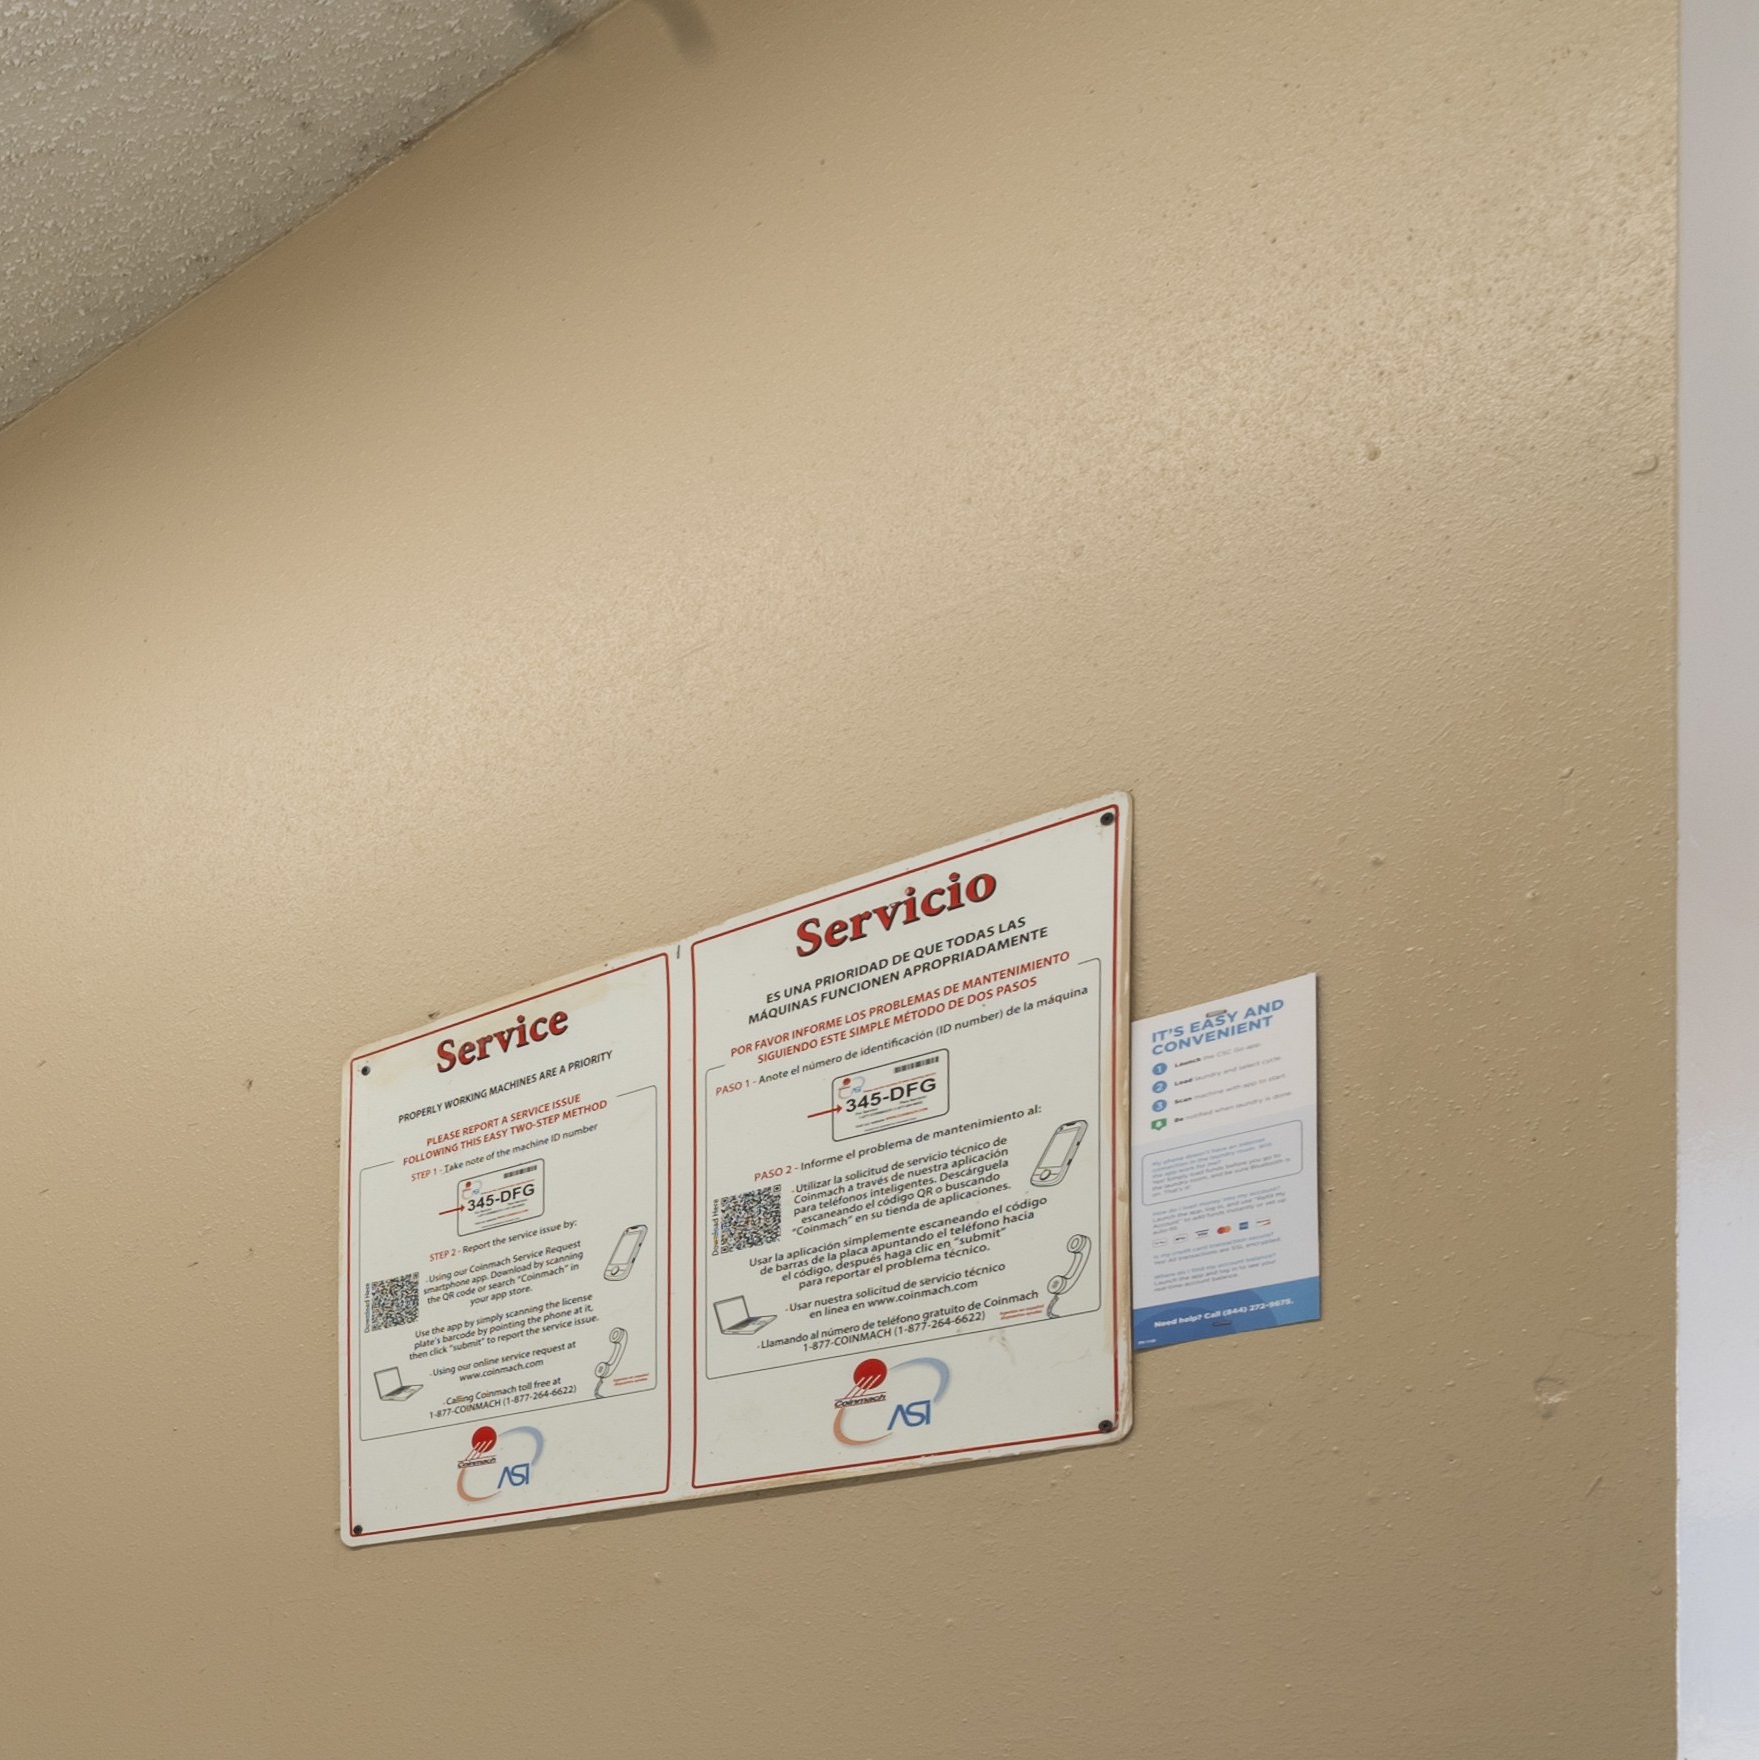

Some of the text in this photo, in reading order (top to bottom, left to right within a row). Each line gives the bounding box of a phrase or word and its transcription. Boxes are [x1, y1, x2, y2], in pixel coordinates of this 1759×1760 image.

[795, 871, 998, 958] Servicio
[748, 926, 1048, 1024] MÁQUINAS FUNCIONEN APROPRIADAMENTE
[766, 916, 1025, 1004] ES UNA PRIORIDAD DE QUE TODAS LAS
[730, 950, 1069, 1057] POR FAVOR INFORME LOS PROBLEMAS DE MANTENIMIENTO
[757, 976, 1036, 1064] SIGUIENDO ESTE SIMPLE MÉTODO DE DOS PASOS
[1152, 999, 1284, 1042] IT'S EASY AND
[436, 1009, 569, 1073] Service
[1152, 1015, 1273, 1056] CONVENIENT
[398, 1049, 612, 1124] PROPERLY WORKING MACHINES ARE A PRIORITY
[846, 1078, 936, 1113] 345-DFG
[403, 1099, 607, 1166] FOLLOWING THIS EASY TWO-STEP METHOD
[427, 1093, 580, 1146] PLEASE REPORT A SERVICE ISSUE
[467, 1183, 535, 1212] 345-DFG
[799, 1244, 989, 1290] para reportar el problema técnico.
[809, 1280, 978, 1318] en línea en www.coinmach.com
[1154, 1317, 1178, 1328] Need
[1178, 1314, 1202, 1324] help?
[1204, 1310, 1221, 1320] Call
[803, 1330, 891, 1352] 1-877-COINMACH
[893, 1311, 986, 1337] (1-877-264-6622)
[459, 1360, 544, 1382] www.coinmach.com
[429, 1385, 577, 1419] 1-877-COINMACH (1-877-264-6622)
